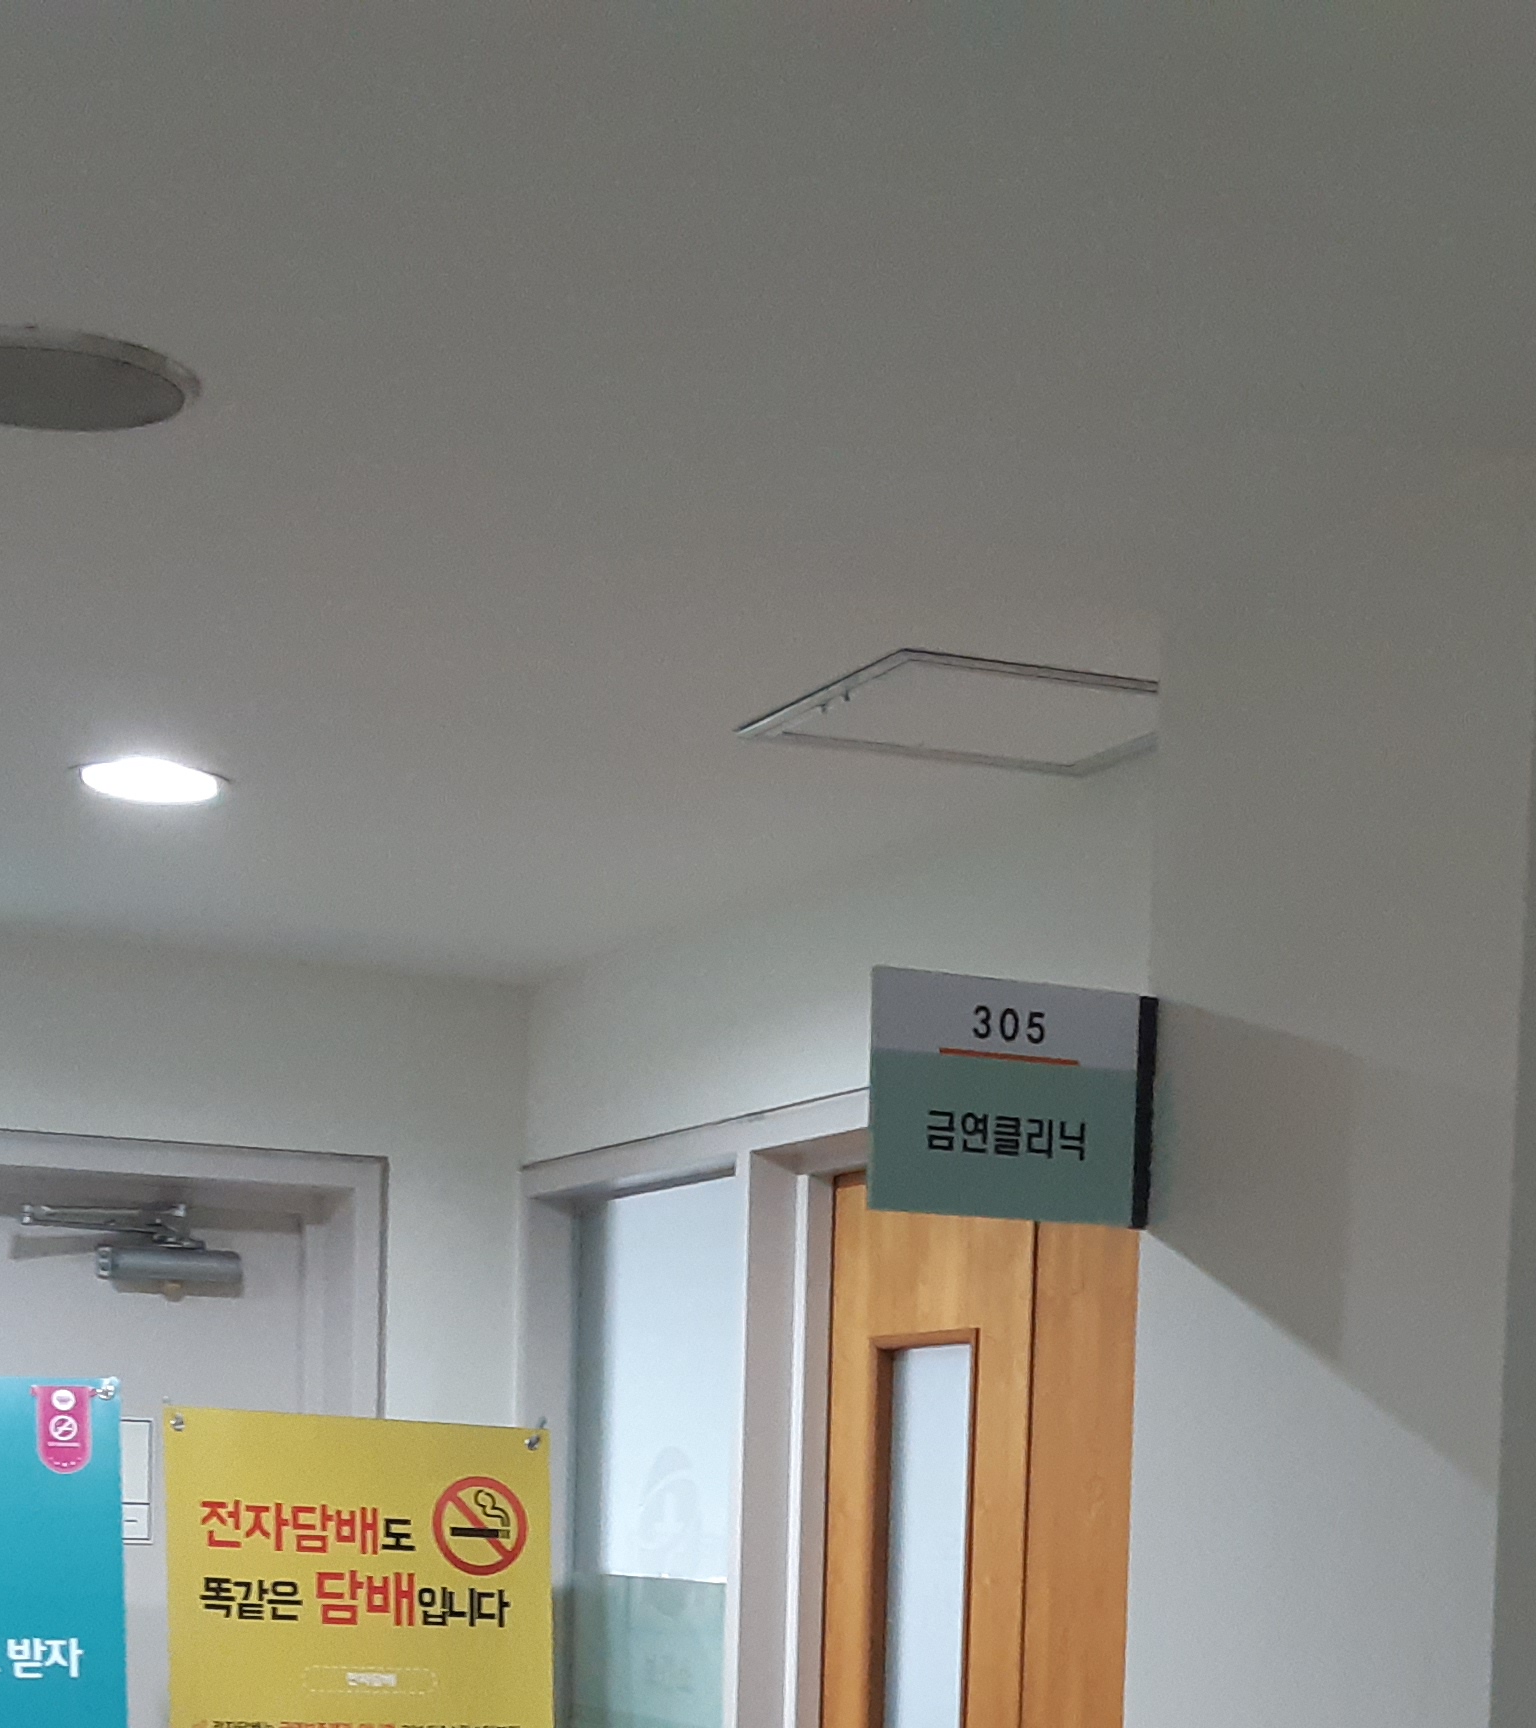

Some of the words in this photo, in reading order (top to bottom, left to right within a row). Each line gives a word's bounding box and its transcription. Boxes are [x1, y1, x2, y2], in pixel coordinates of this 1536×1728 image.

[972, 1005, 1046, 1044] 305
[926, 1109, 1086, 1161] 금연클리닉
[199, 1498, 416, 1555] 전자담배도
[199, 1576, 303, 1621] 똑같은
[315, 1570, 511, 1628] 담배입니다
[7, 1637, 84, 1679] 받자
